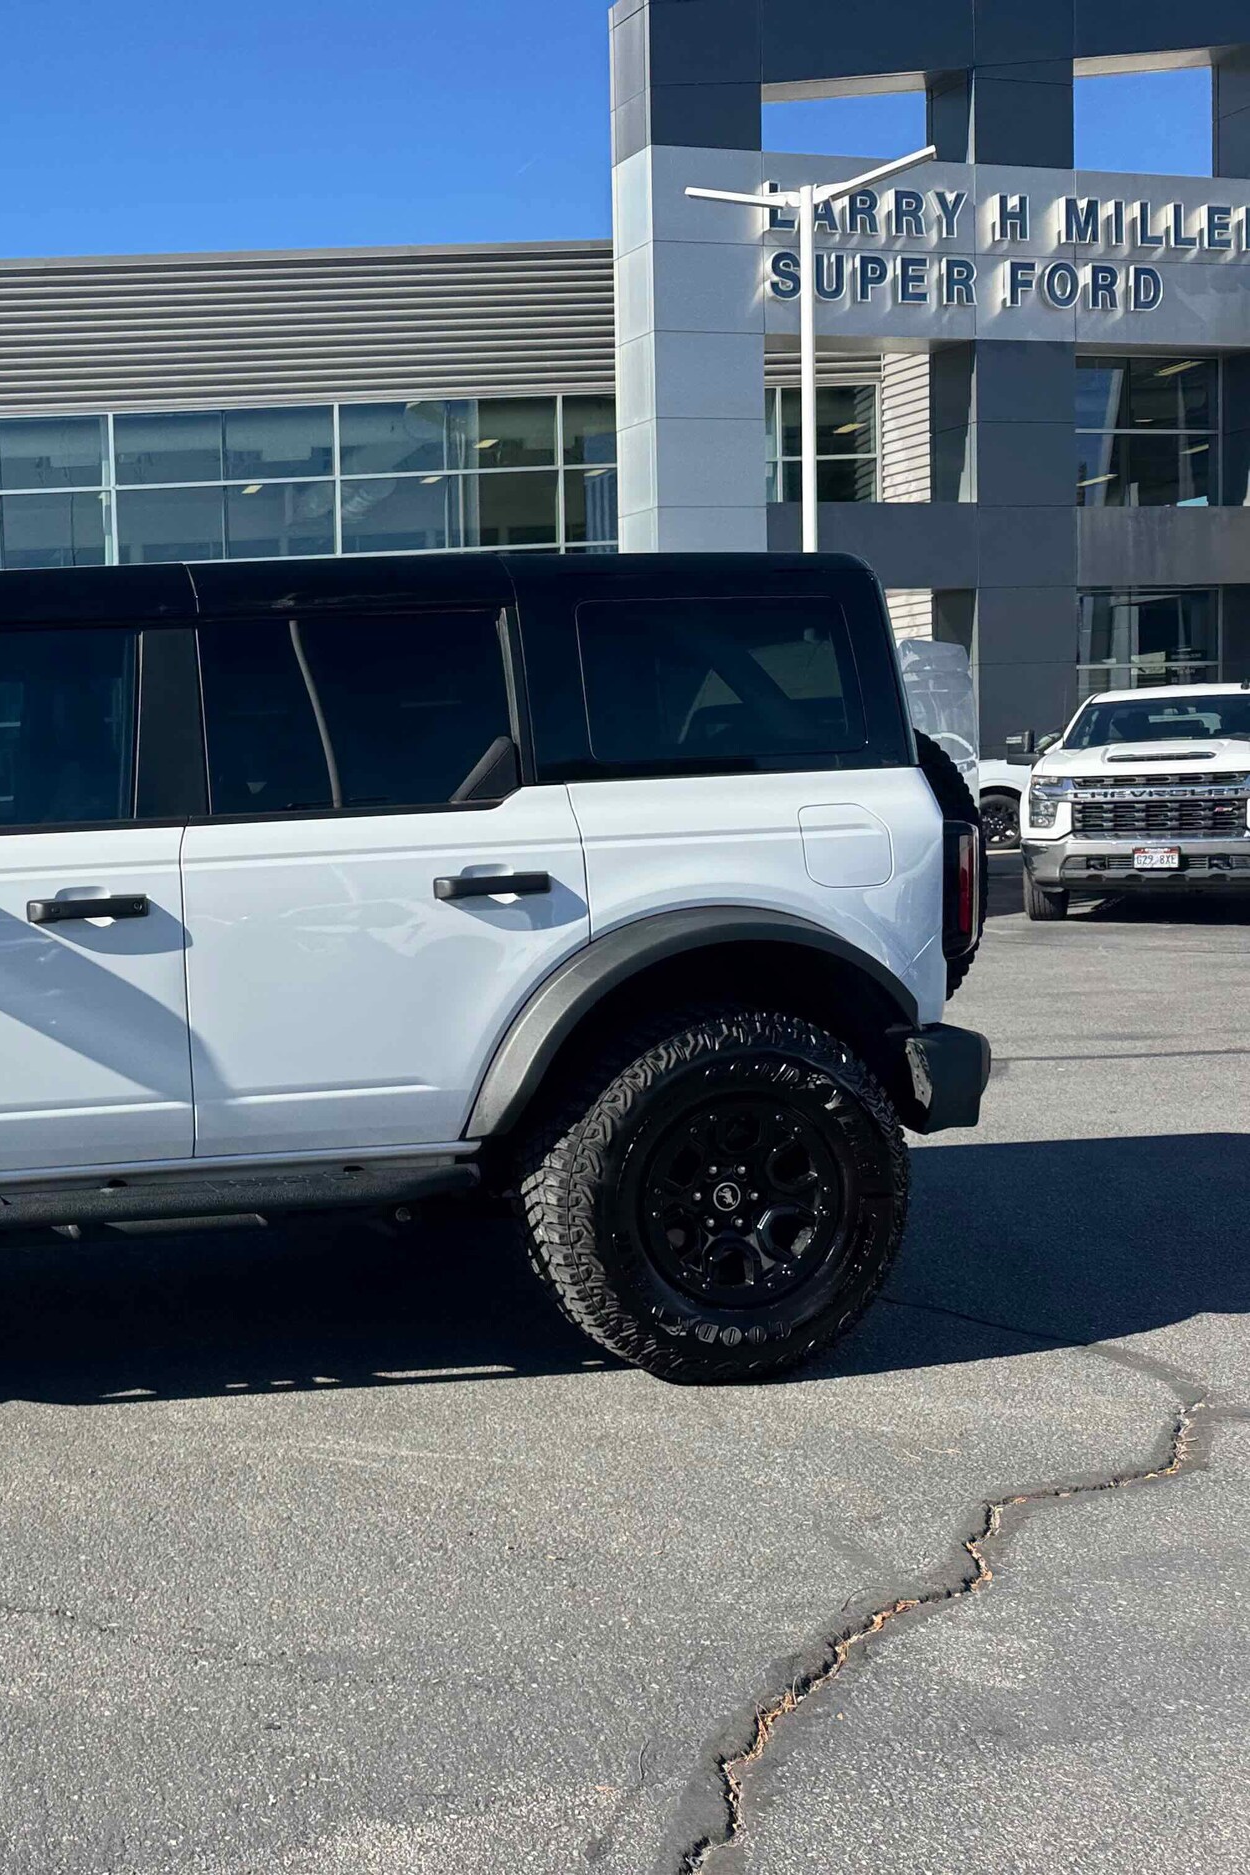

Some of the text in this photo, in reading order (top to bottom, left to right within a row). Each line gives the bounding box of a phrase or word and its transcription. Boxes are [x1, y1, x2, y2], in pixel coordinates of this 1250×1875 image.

[763, 180, 968, 238] LARRY
[992, 192, 1030, 241] H
[770, 251, 1164, 311] SUPER FORD
[1072, 787, 1246, 799] CHEVROLET
